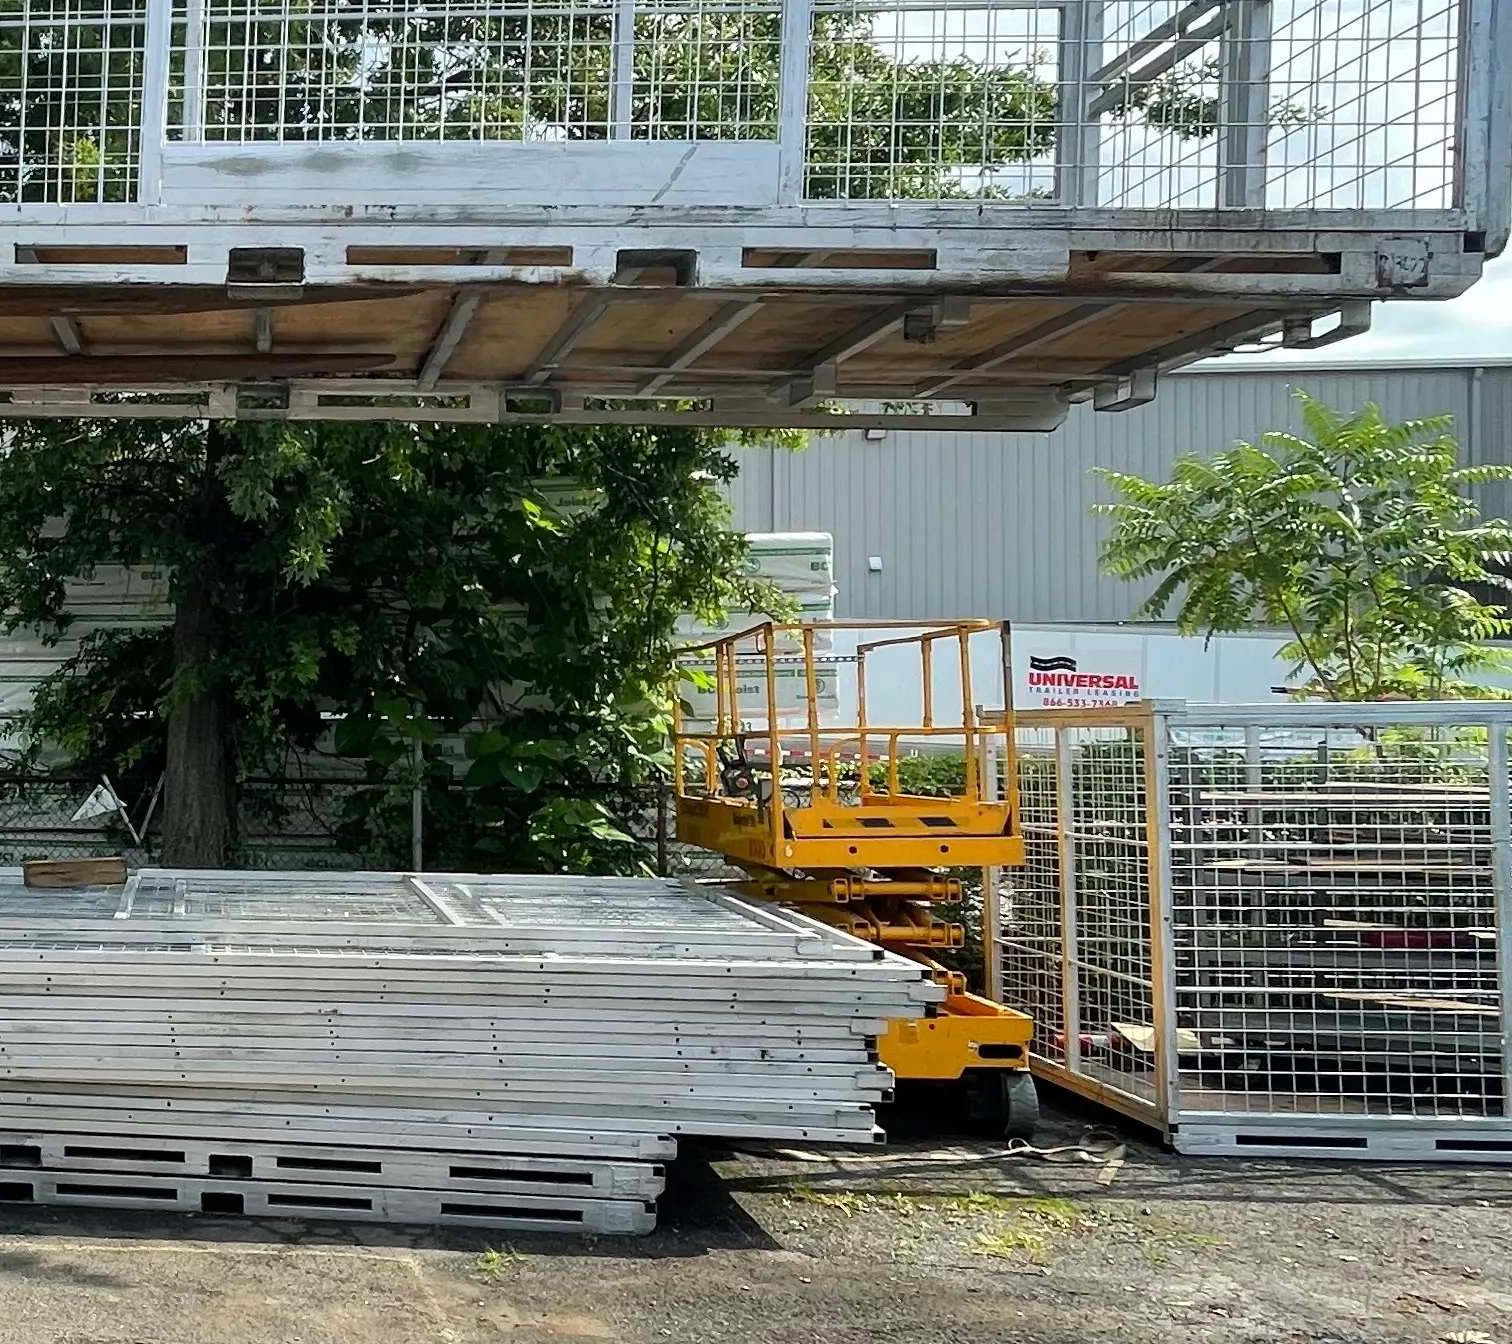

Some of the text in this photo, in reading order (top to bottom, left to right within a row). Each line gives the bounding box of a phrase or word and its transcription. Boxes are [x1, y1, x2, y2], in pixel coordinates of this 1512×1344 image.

[1028, 672, 1139, 690] UNIVERSAL
[1028, 687, 1140, 698] TRAILER LEASING
